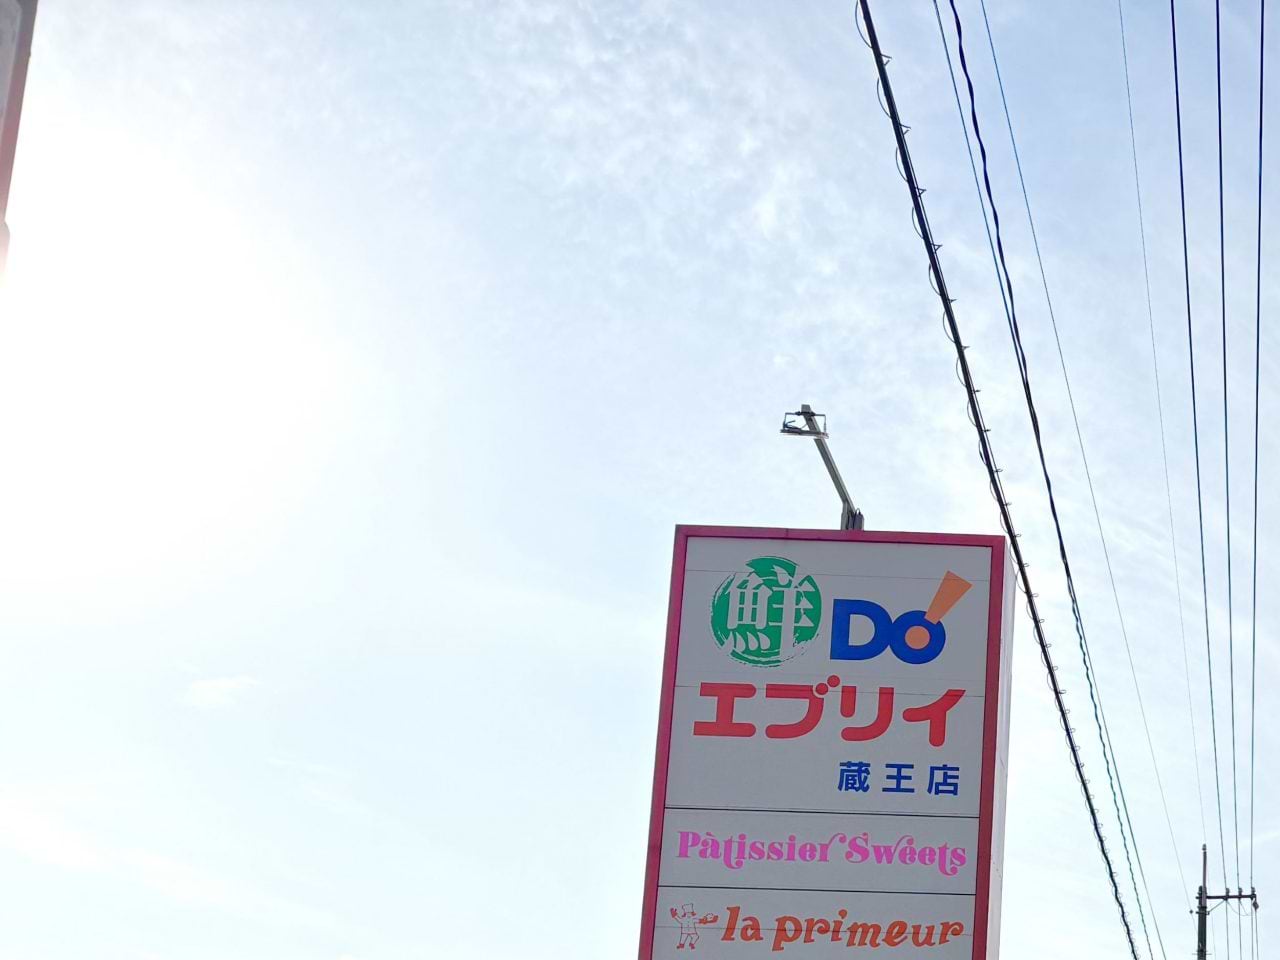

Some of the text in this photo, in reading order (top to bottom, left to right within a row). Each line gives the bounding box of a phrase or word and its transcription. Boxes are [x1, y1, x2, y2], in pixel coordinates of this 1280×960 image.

[693, 674, 967, 747] エブリイ
[837, 760, 960, 796] 蔵王店
[721, 906, 964, 951] la primeur
